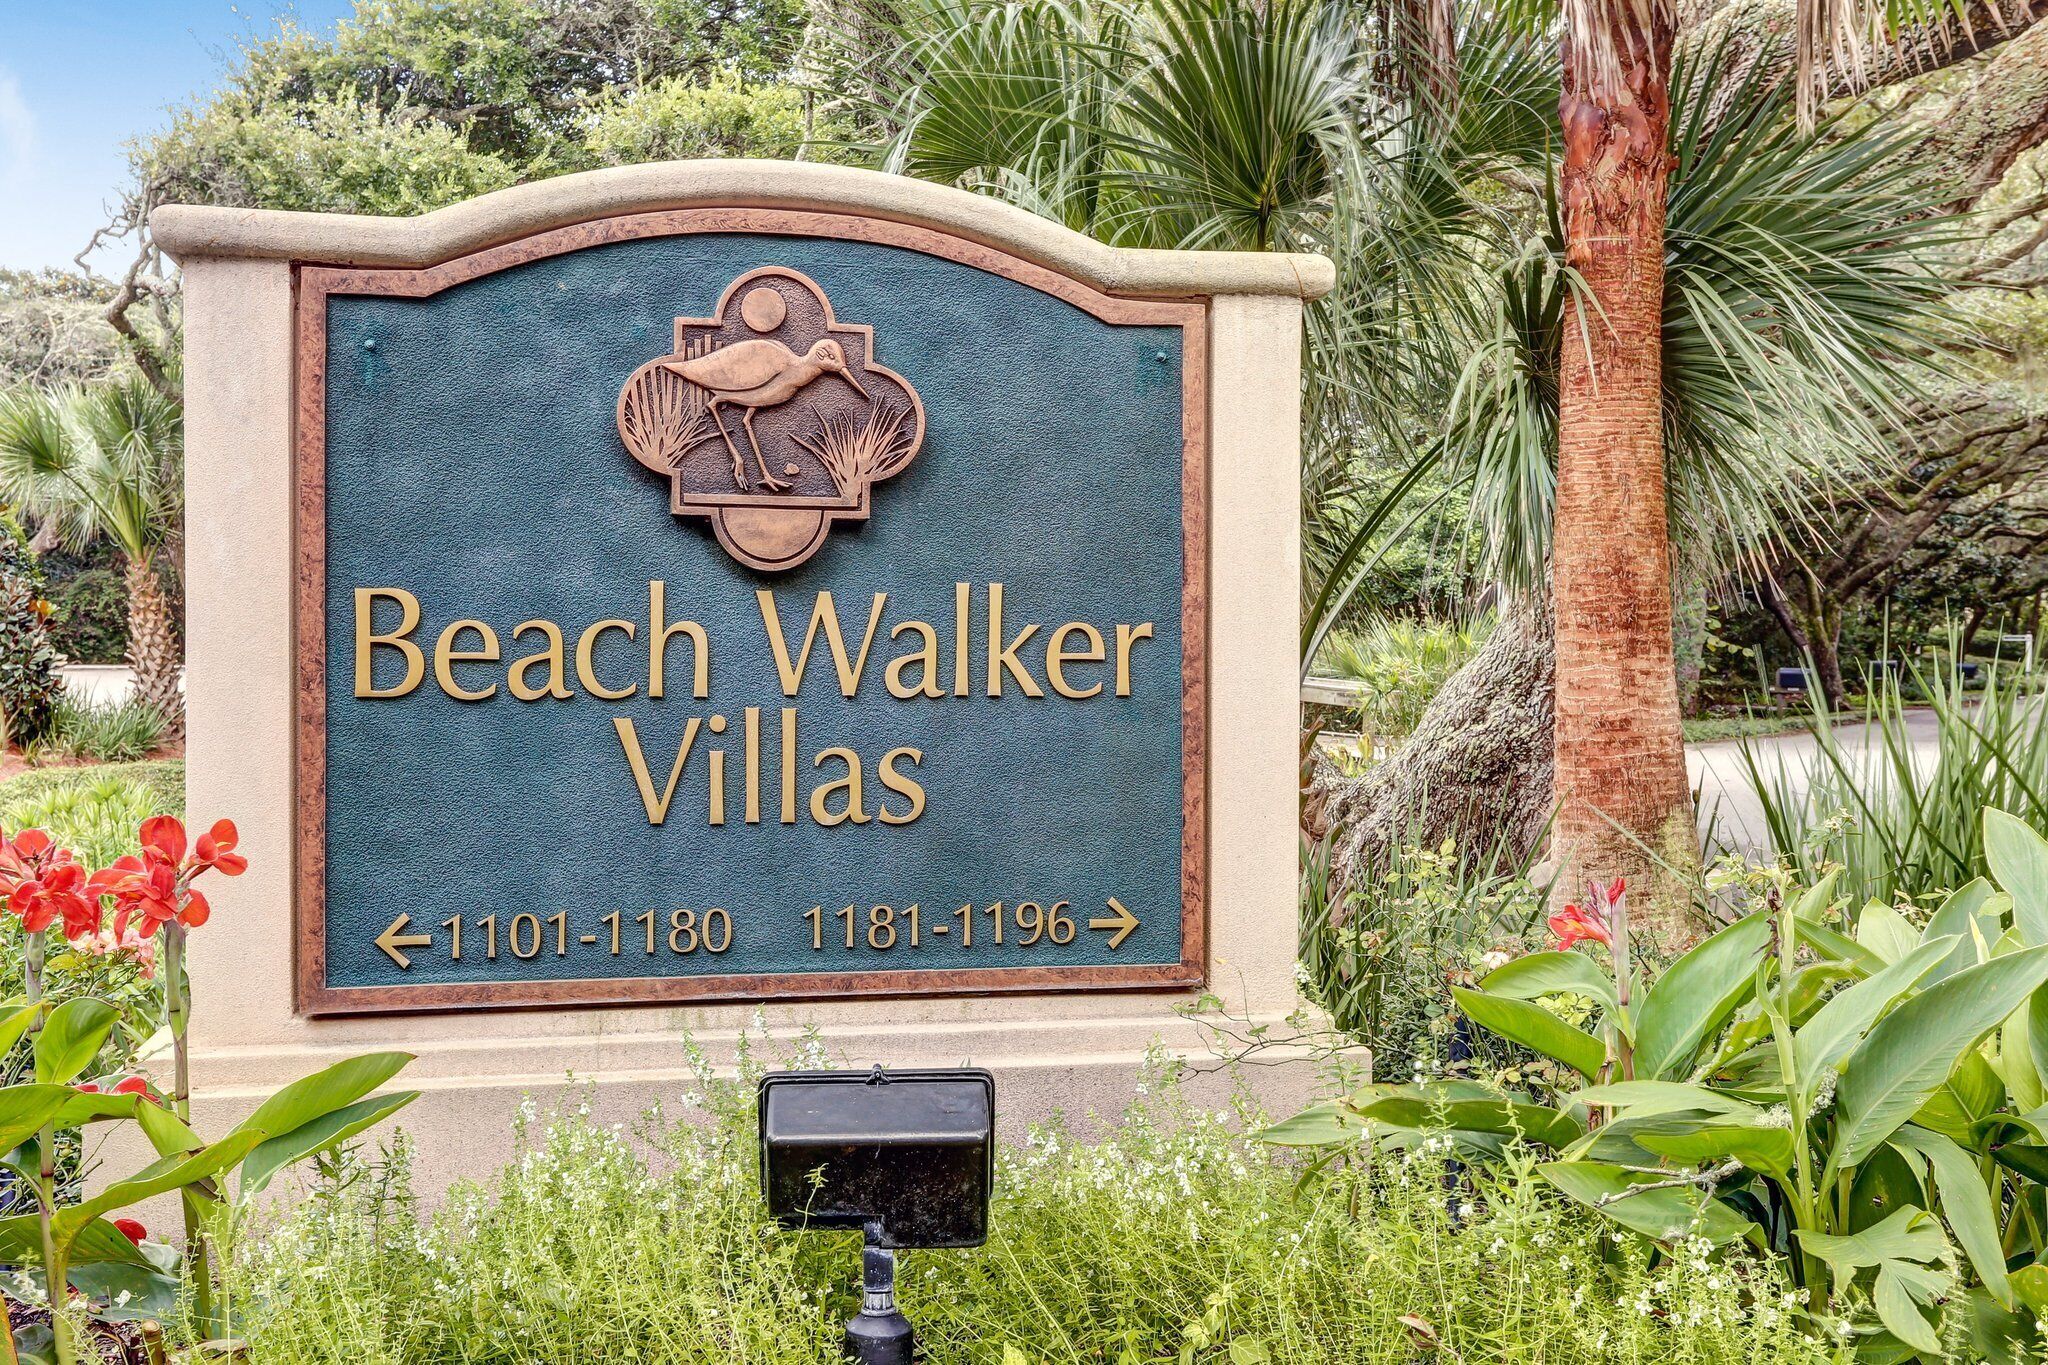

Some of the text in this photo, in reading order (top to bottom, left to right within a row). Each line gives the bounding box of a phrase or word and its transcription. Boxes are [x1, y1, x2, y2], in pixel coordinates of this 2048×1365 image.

[353, 580, 1154, 701] Beach Walker
[612, 707, 926, 826] Villas
[441, 908, 733, 960] 1101-1180
[802, 900, 1076, 949] 1181-1196
